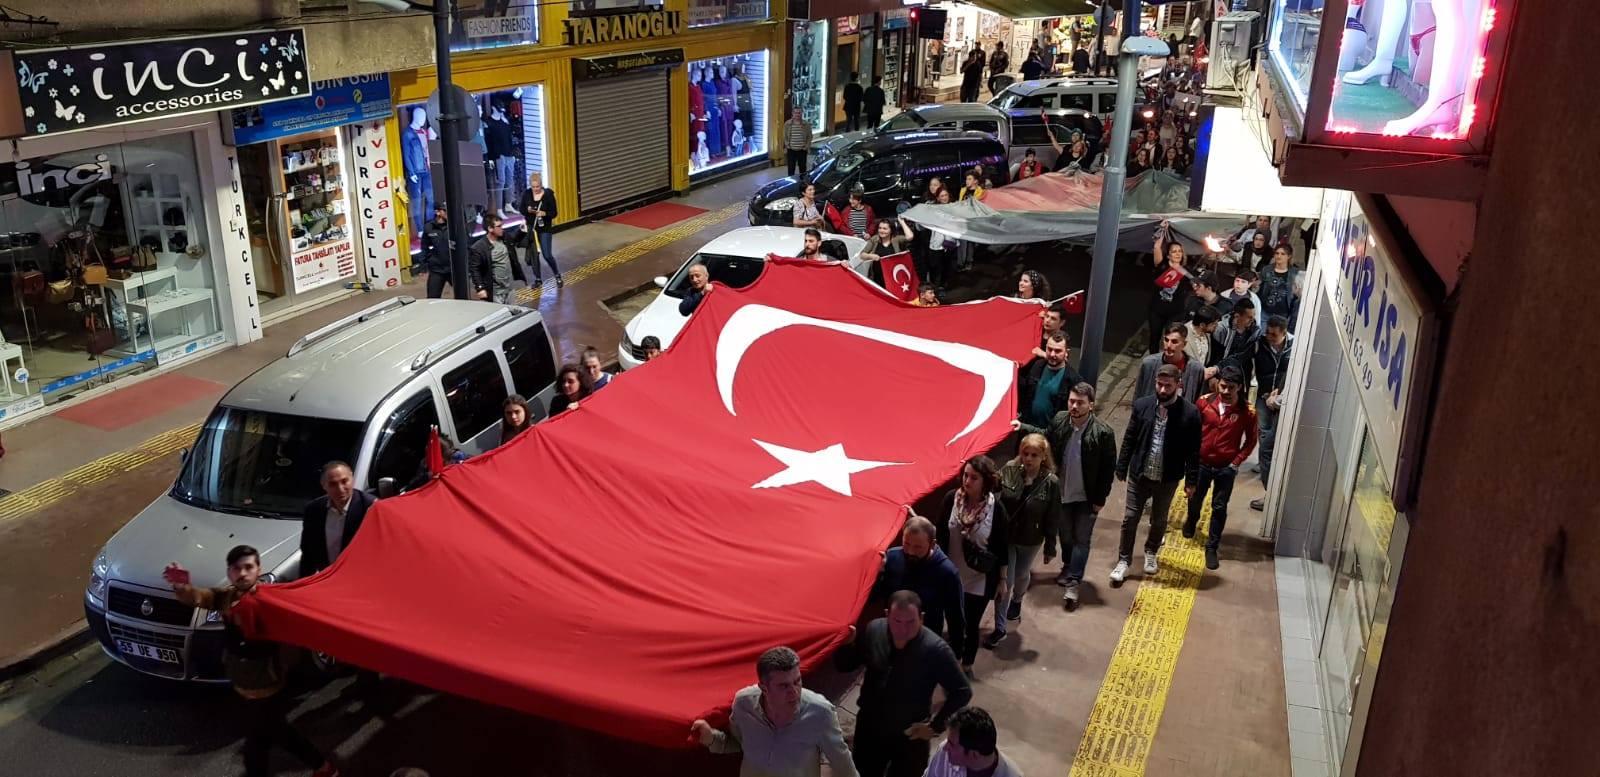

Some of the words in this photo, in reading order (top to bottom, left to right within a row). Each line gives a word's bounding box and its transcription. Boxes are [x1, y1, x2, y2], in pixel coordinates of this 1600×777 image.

[116, 88, 243, 118] accessories
[15, 153, 112, 196] inci
[354, 124, 380, 279] TURKCELL
[371, 138, 398, 288] vodafone
[227, 156, 258, 330] TURKCELL
[137, 643, 152, 657] UE
